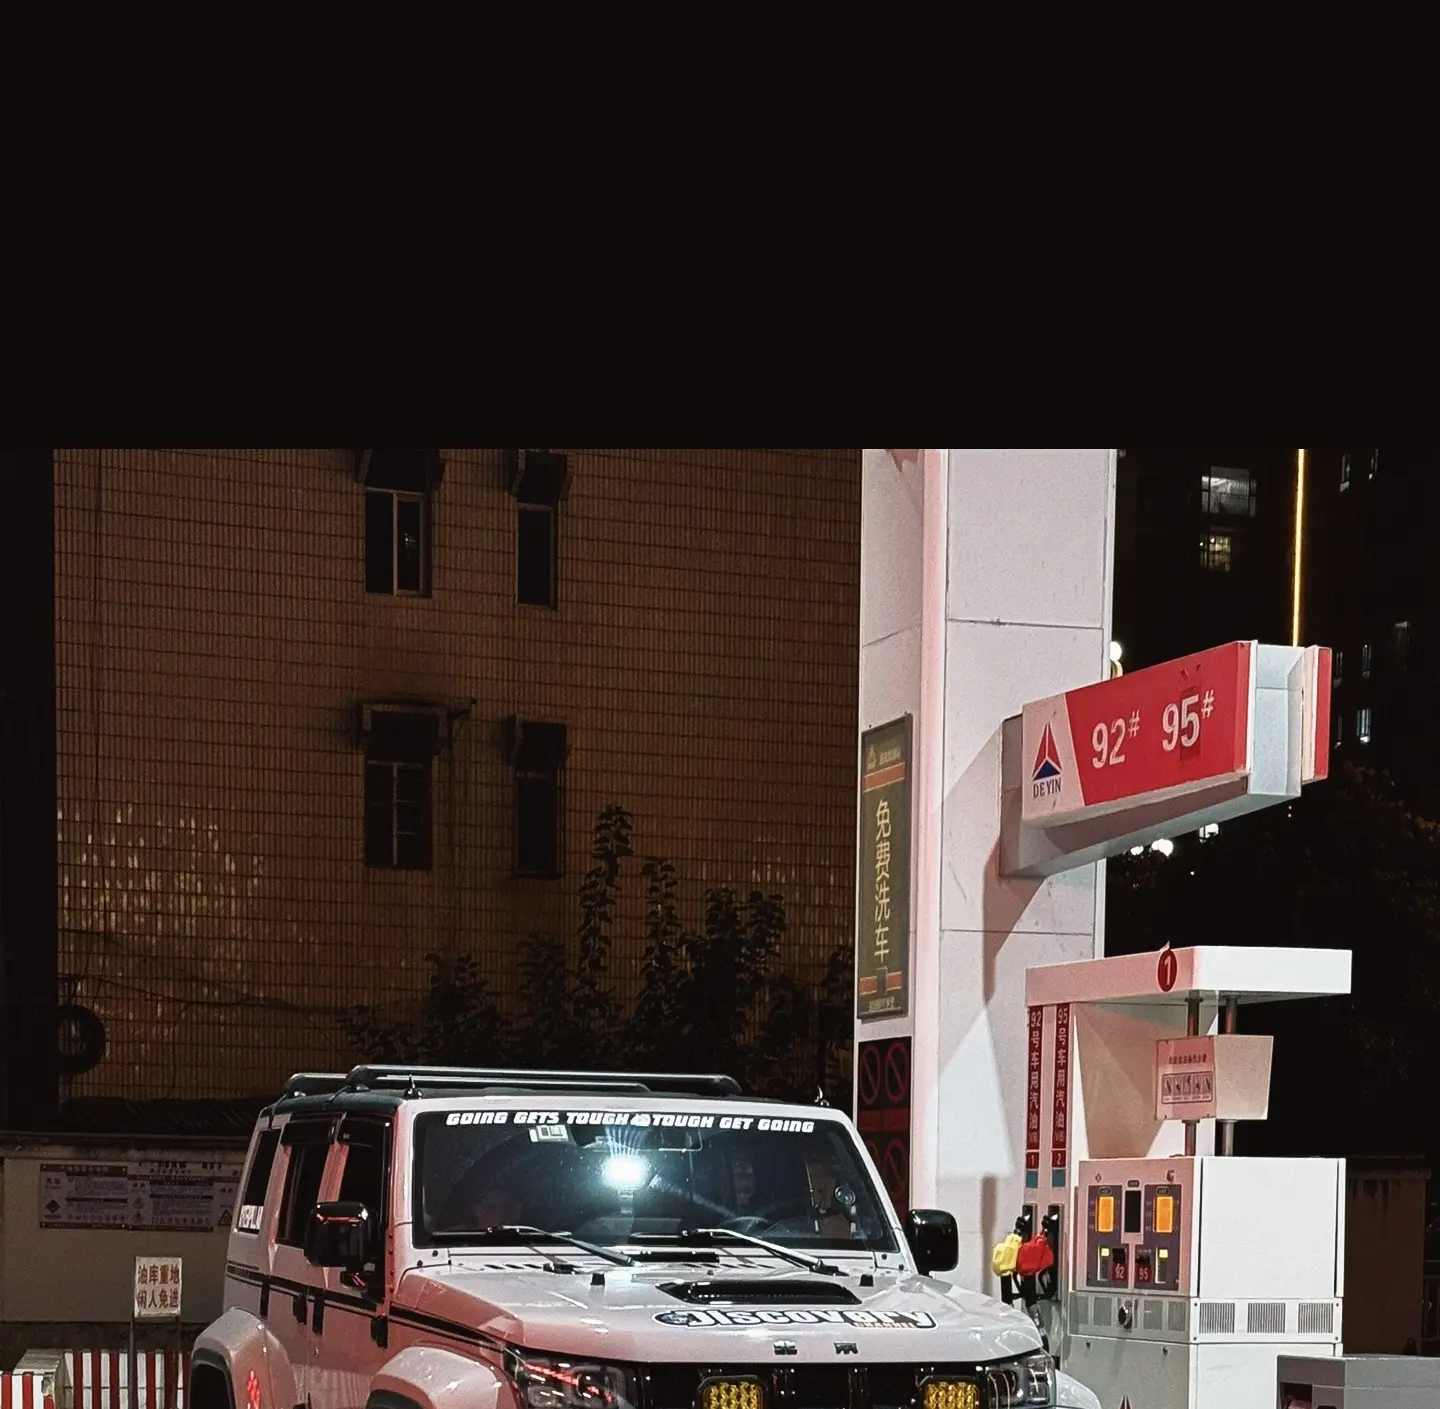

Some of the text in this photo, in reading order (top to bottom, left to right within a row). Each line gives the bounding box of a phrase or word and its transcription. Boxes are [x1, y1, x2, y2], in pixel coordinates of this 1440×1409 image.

[874, 799, 892, 963] 免费洗车
[1164, 955, 1173, 986] 1
[446, 1111, 630, 1126] GOING GETS TOUGH
[651, 1113, 815, 1133] TOUGH GET GOING
[137, 1264, 180, 1285] 油库重地
[1115, 1264, 1124, 1279] 92
[1138, 1267, 1149, 1280] 95
[137, 1289, 179, 1308] 闲人免进
